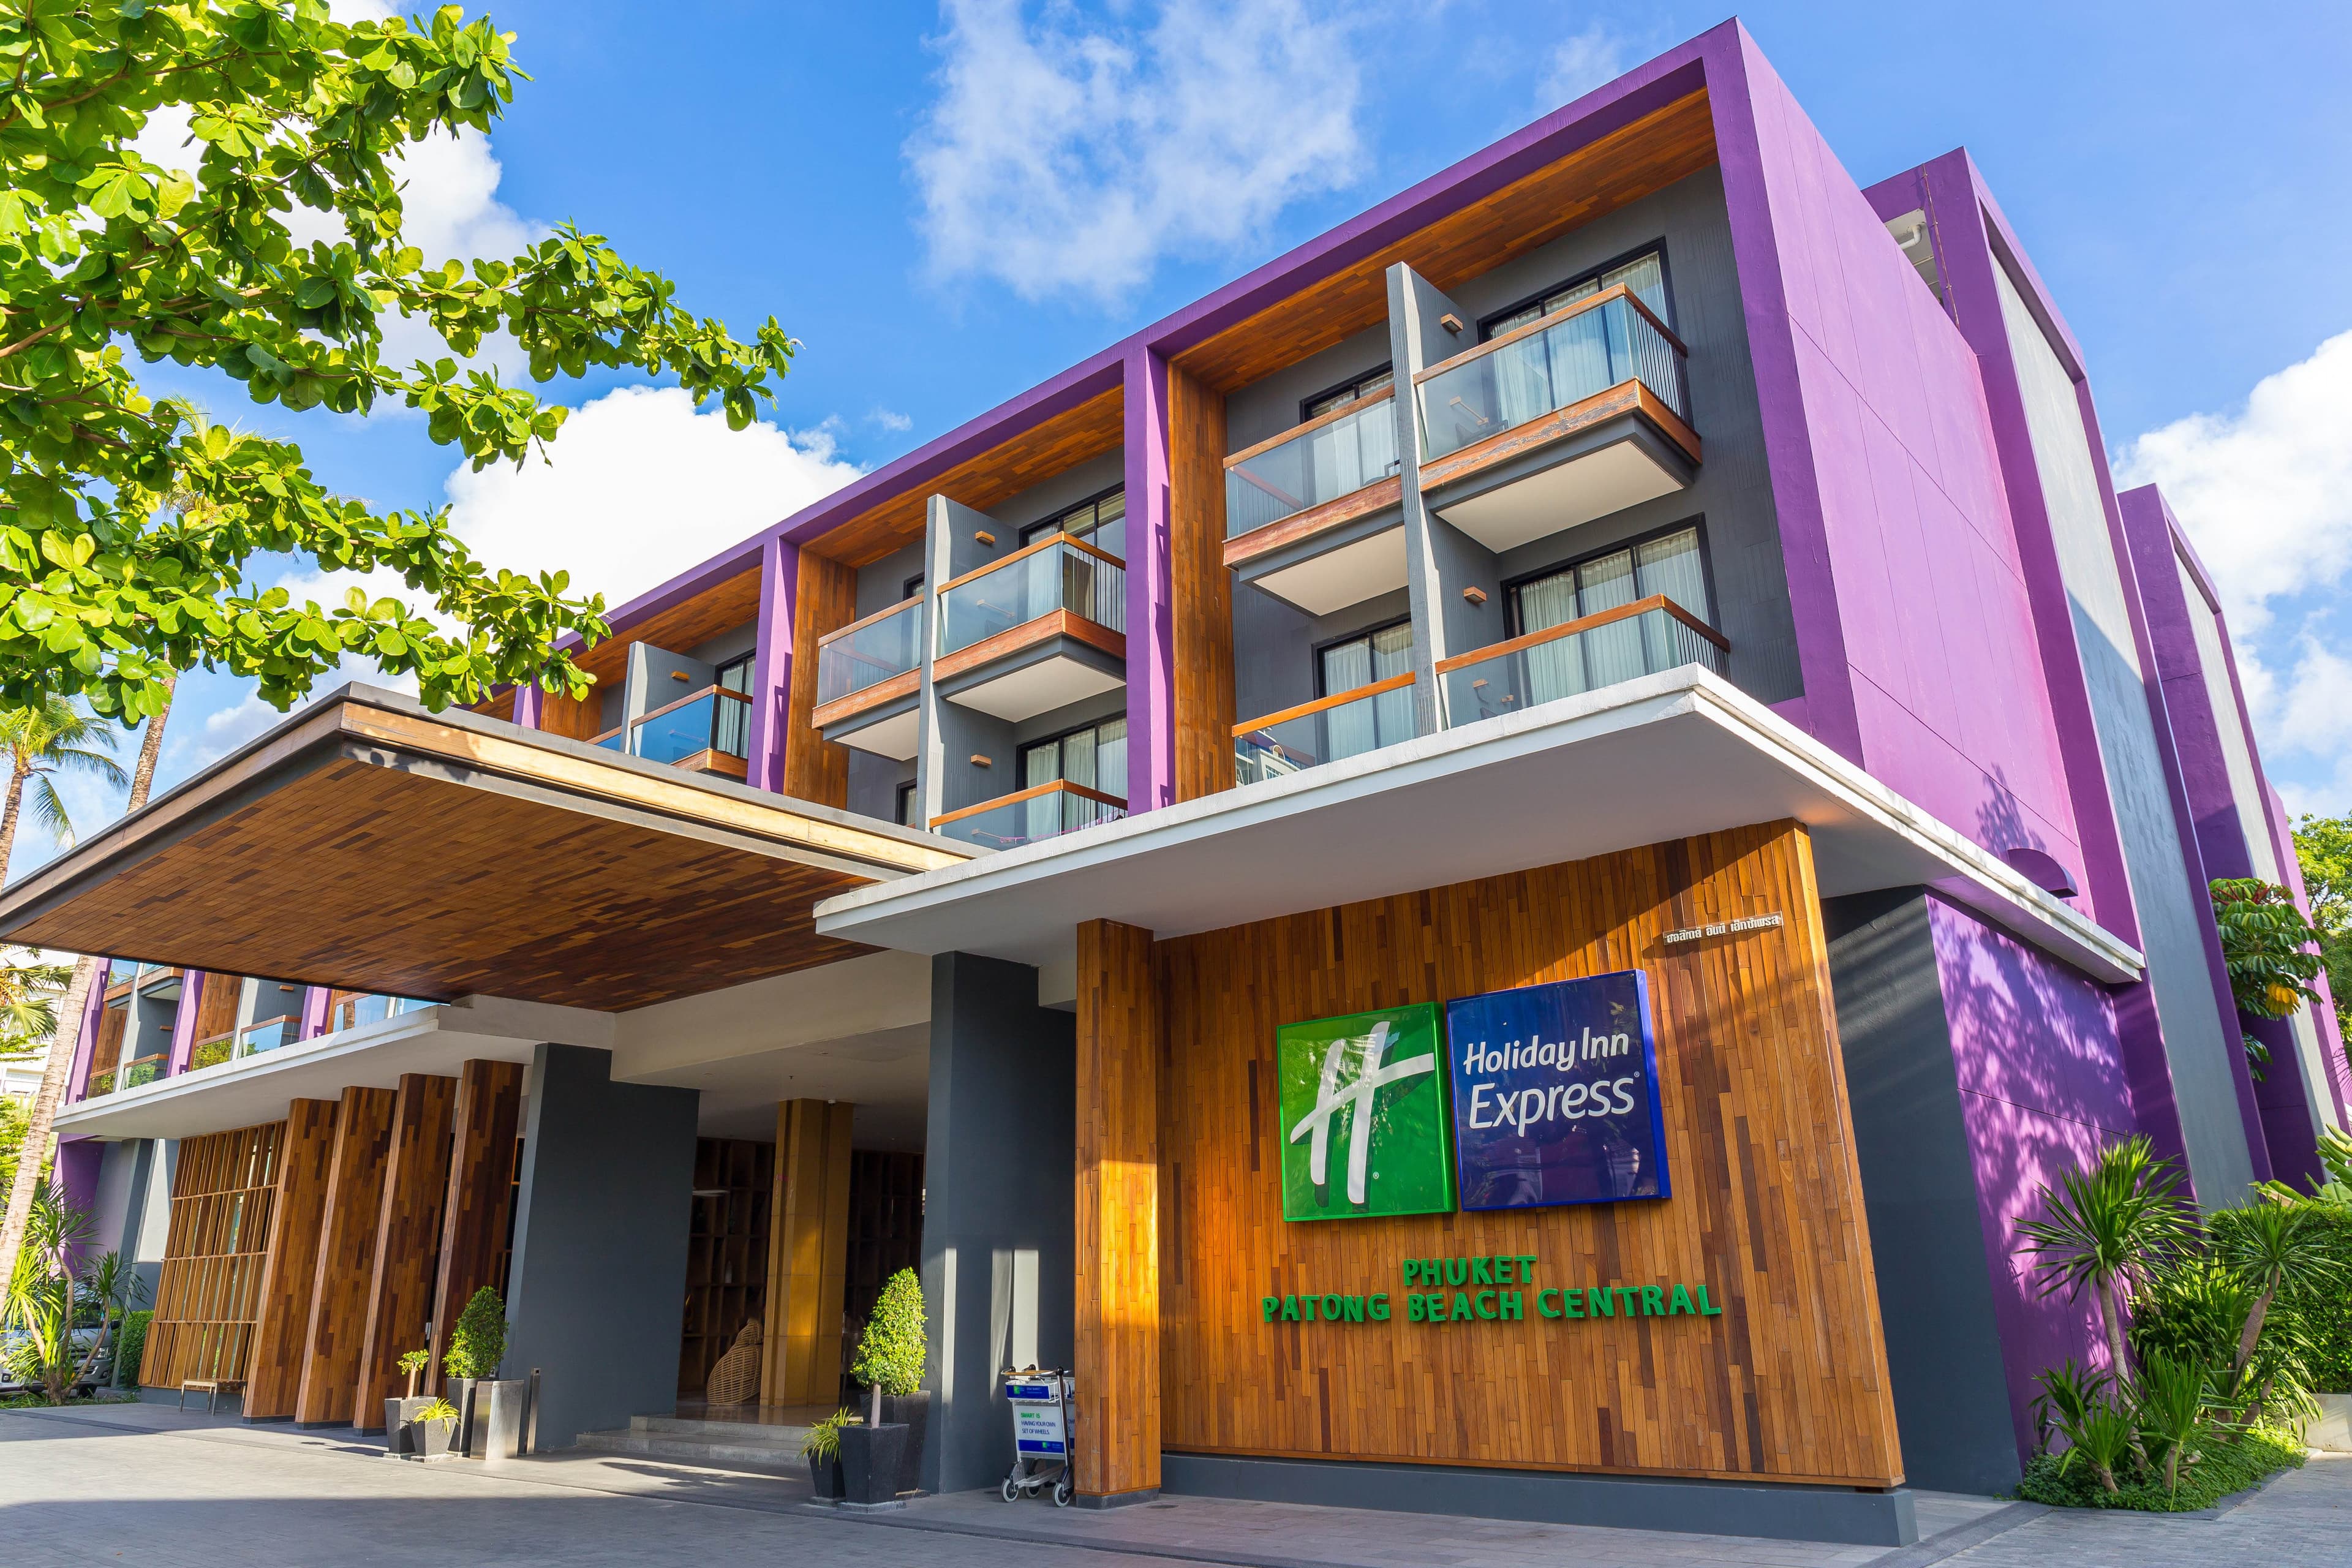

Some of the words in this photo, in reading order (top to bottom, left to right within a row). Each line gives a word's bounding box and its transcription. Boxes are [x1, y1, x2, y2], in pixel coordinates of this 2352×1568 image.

[1667, 926, 1702, 943] ฮอลิเดย์
[1705, 922, 1726, 937] อินน์
[1463, 1035, 1576, 1075] Holiday
[1581, 1027, 1629, 1060] Inn
[1469, 1077, 1635, 1137] Express
[1403, 1255, 1537, 1286] PHUKET
[1262, 1293, 1390, 1322] PATONG
[1408, 1290, 1524, 1322] BEACH
[1537, 1283, 1722, 1318] CENTRAL
